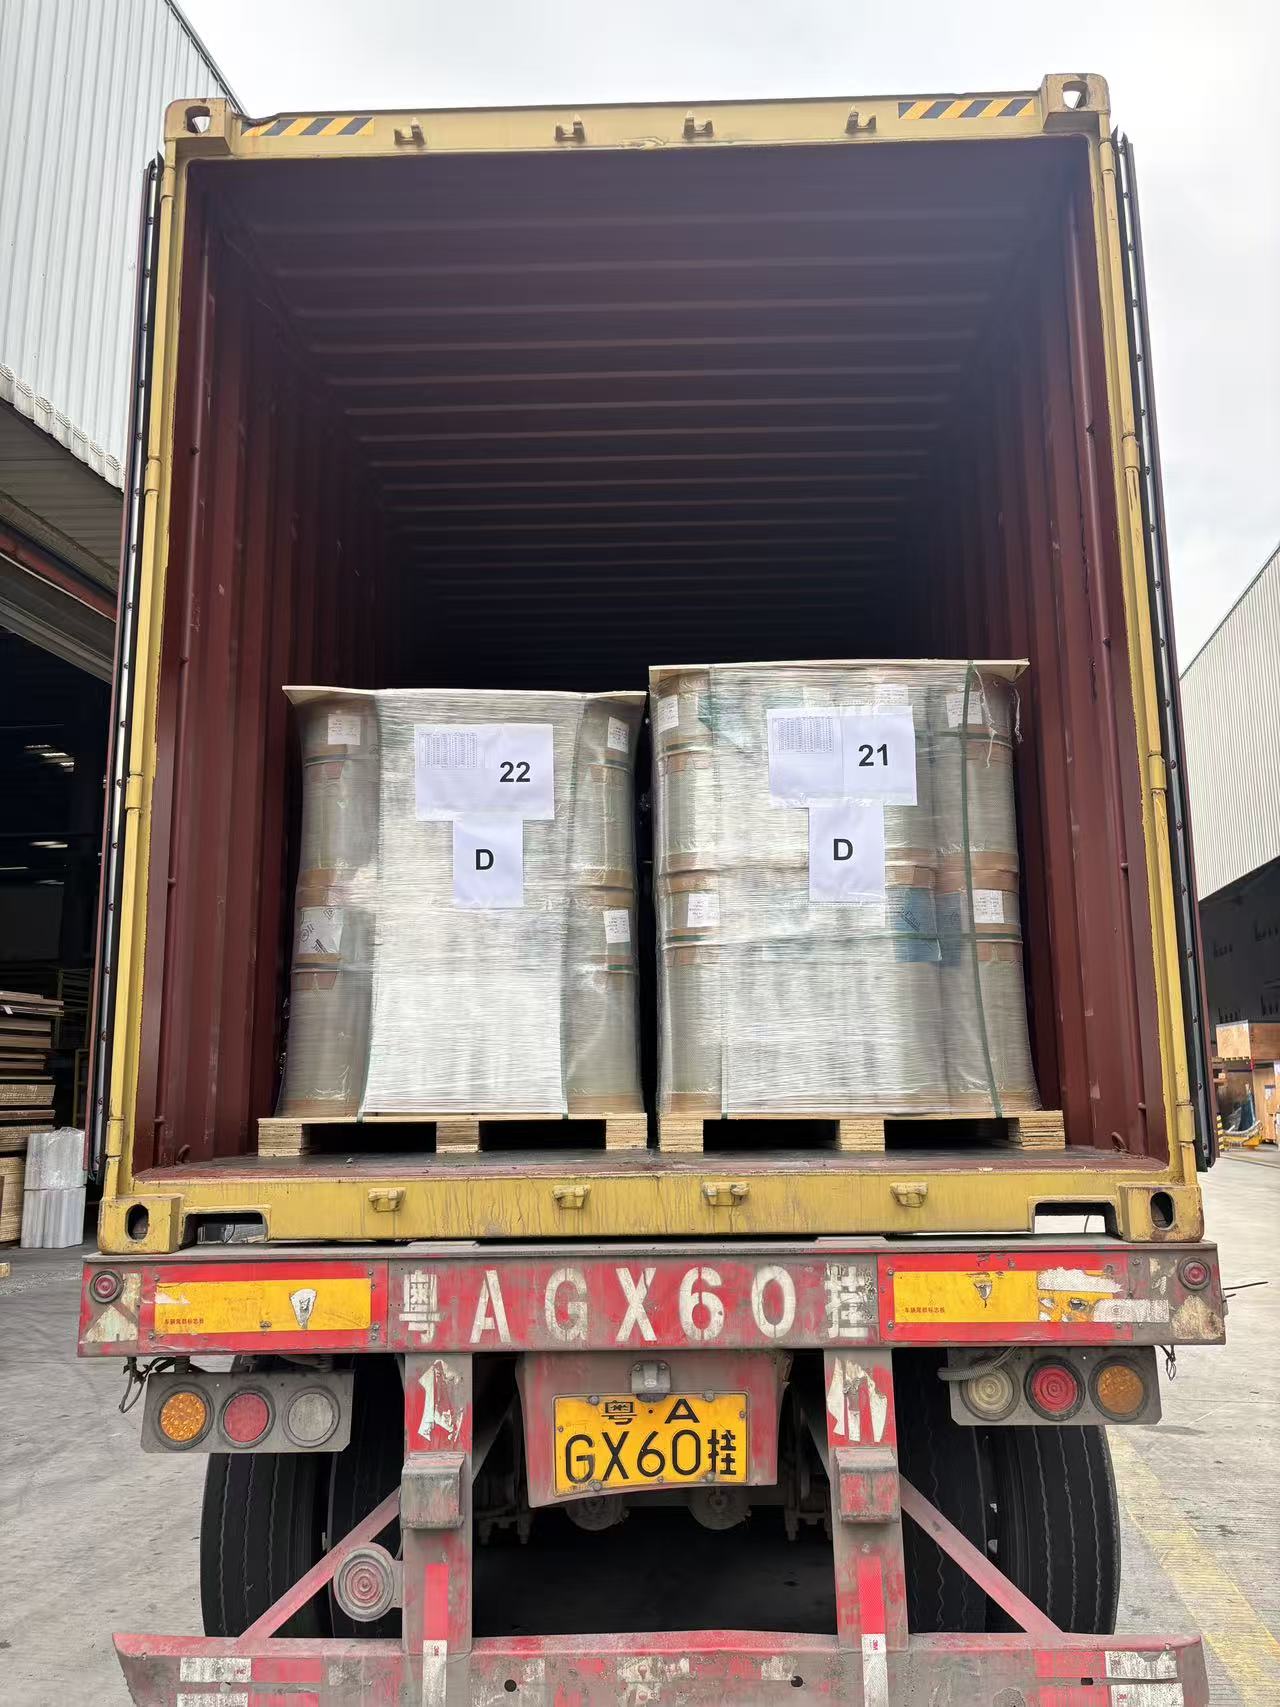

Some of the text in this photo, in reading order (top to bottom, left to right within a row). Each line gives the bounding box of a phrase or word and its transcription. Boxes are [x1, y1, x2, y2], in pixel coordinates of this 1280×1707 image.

[858, 743, 889, 767] 21
[499, 761, 531, 783] 22
[475, 848, 495, 871] D
[833, 838, 854, 861] D
[565, 1429, 737, 1484] GX60挂
